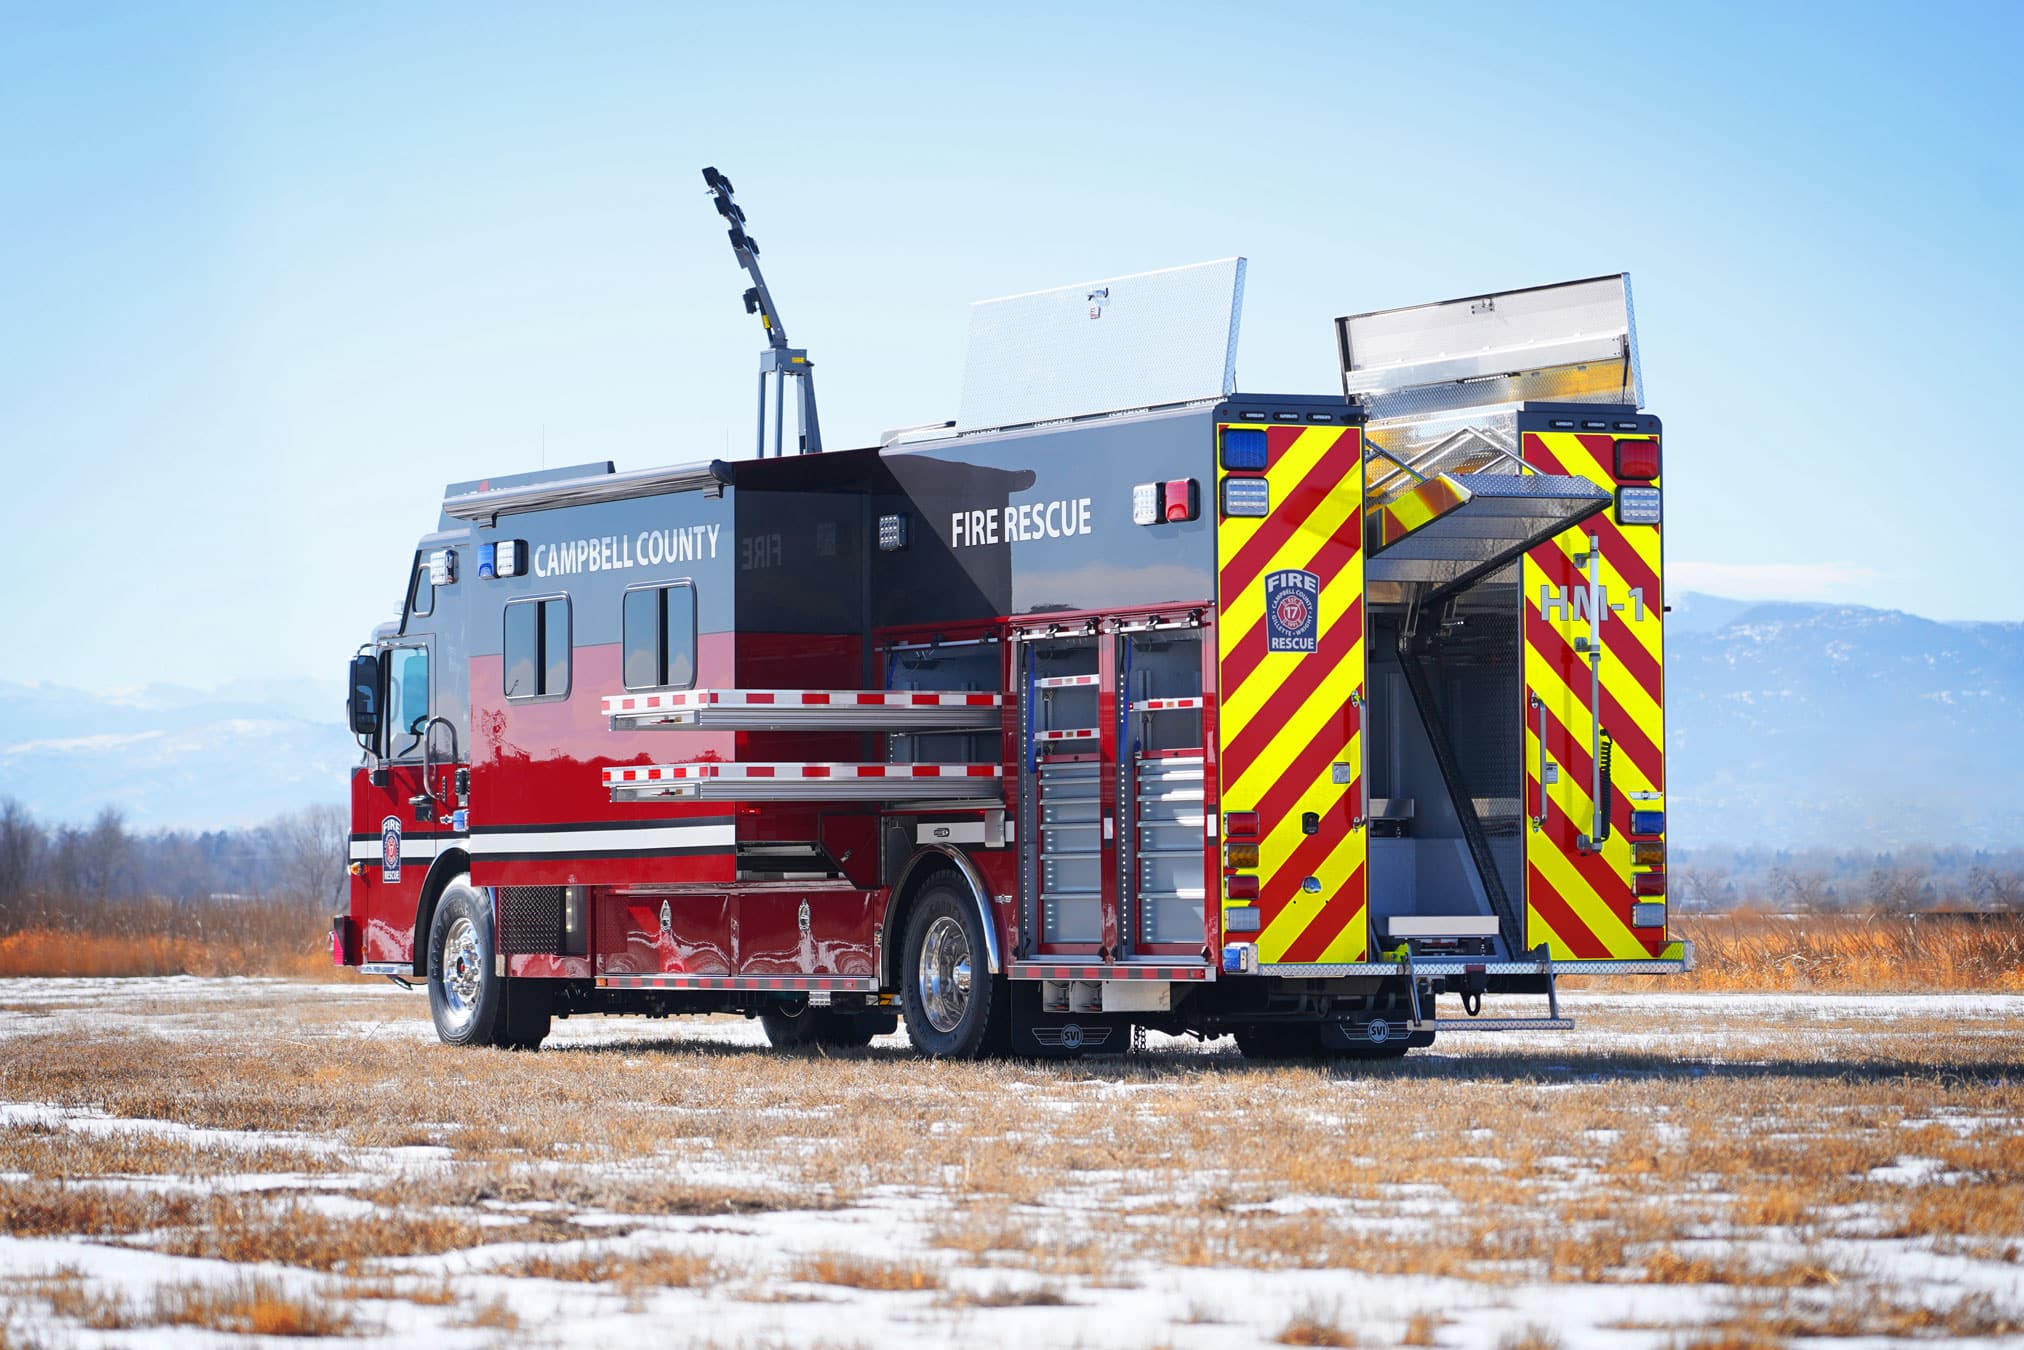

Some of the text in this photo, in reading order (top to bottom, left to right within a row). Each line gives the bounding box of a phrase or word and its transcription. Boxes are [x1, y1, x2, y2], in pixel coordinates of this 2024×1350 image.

[952, 498, 1092, 548] FIRE RESCUE
[534, 523, 721, 578] CAMPBELL COUNTY
[1267, 572, 1317, 593] FIRE
[1272, 588, 1313, 610] CAMPBELL COUNTY
[1540, 584, 1645, 622] HM-1
[1285, 606, 1299, 619] 17
[1271, 637, 1314, 649] RESCUE
[383, 818, 401, 835] FIRE
[1064, 1031, 1080, 1041] SVI
[1371, 1025, 1386, 1036] SVI
